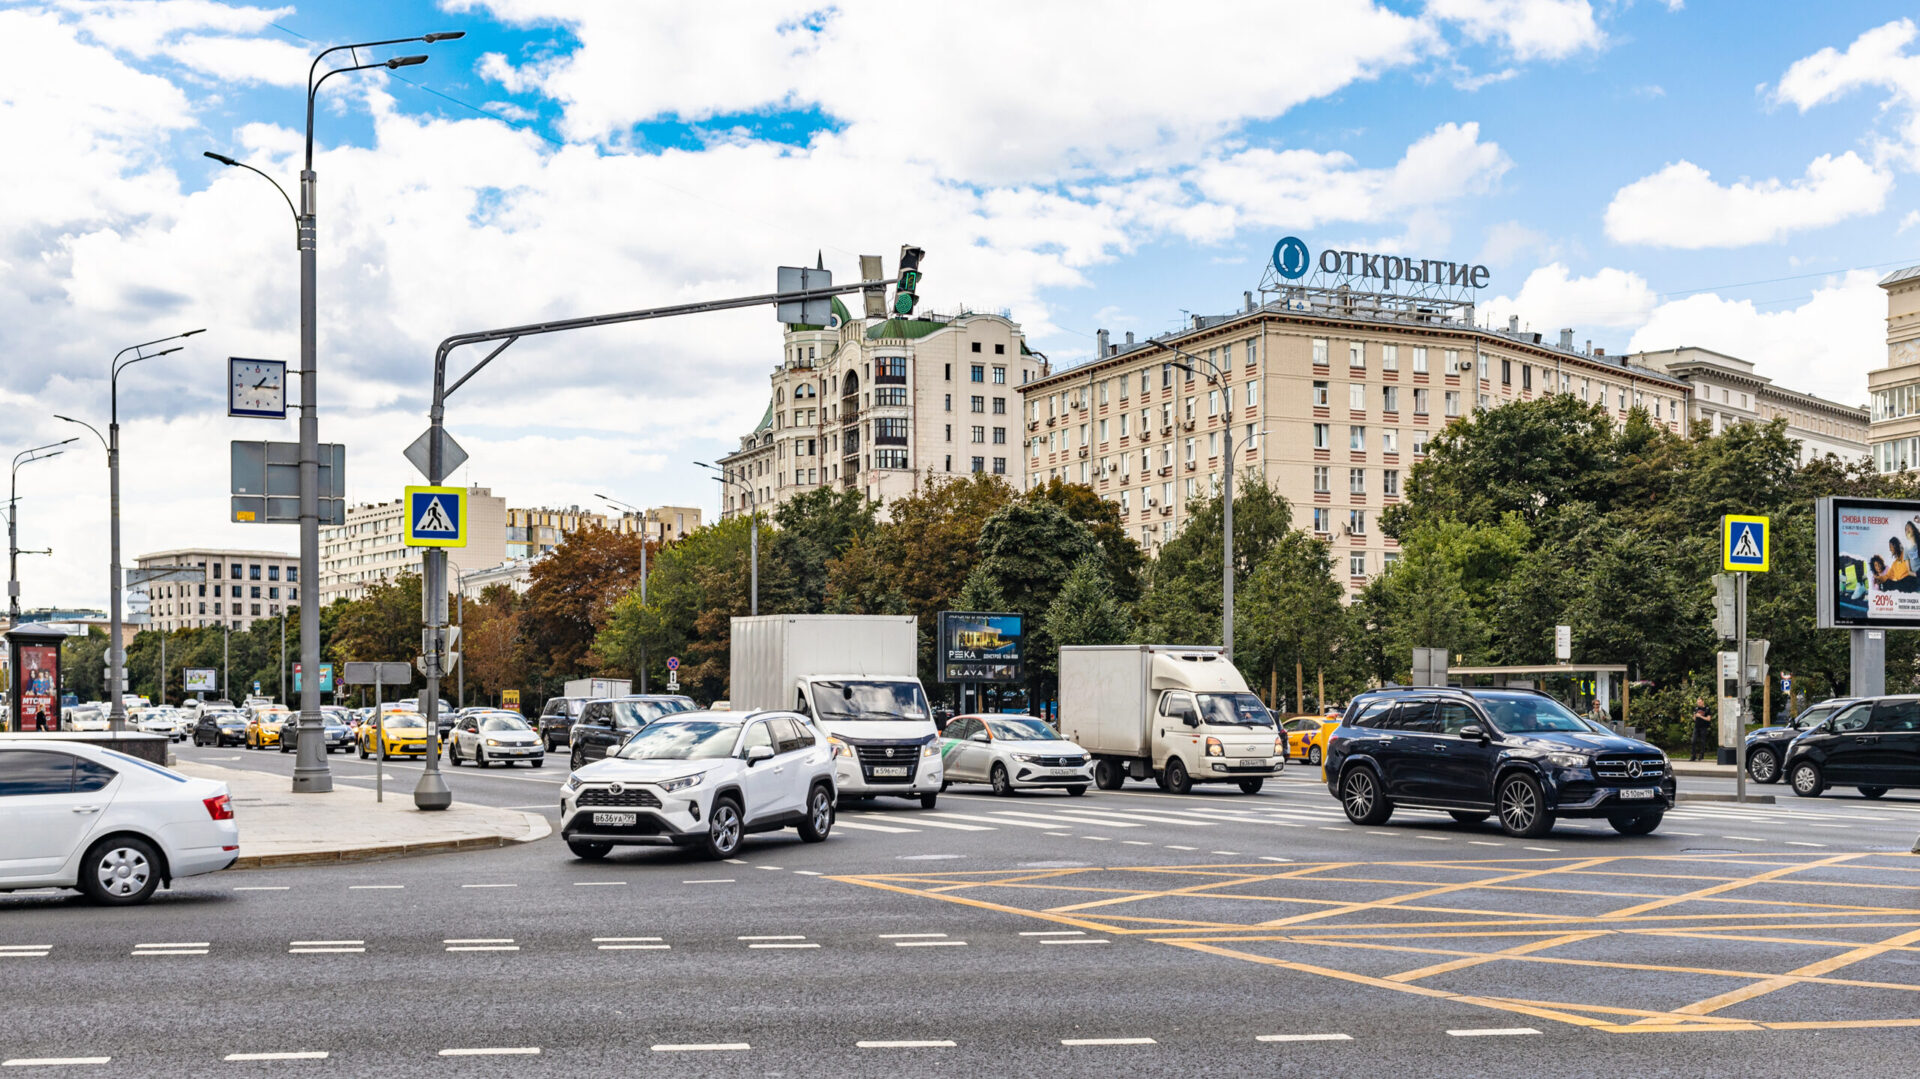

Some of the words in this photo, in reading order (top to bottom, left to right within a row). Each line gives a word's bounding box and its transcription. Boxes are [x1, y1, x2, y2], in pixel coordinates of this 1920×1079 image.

[1320, 249, 1490, 289] открытие
[1842, 515, 1861, 524] СНОВА
[1862, 516, 1867, 524] В
[1868, 516, 1889, 525] REEBOK
[1873, 594, 1893, 606] -20%
